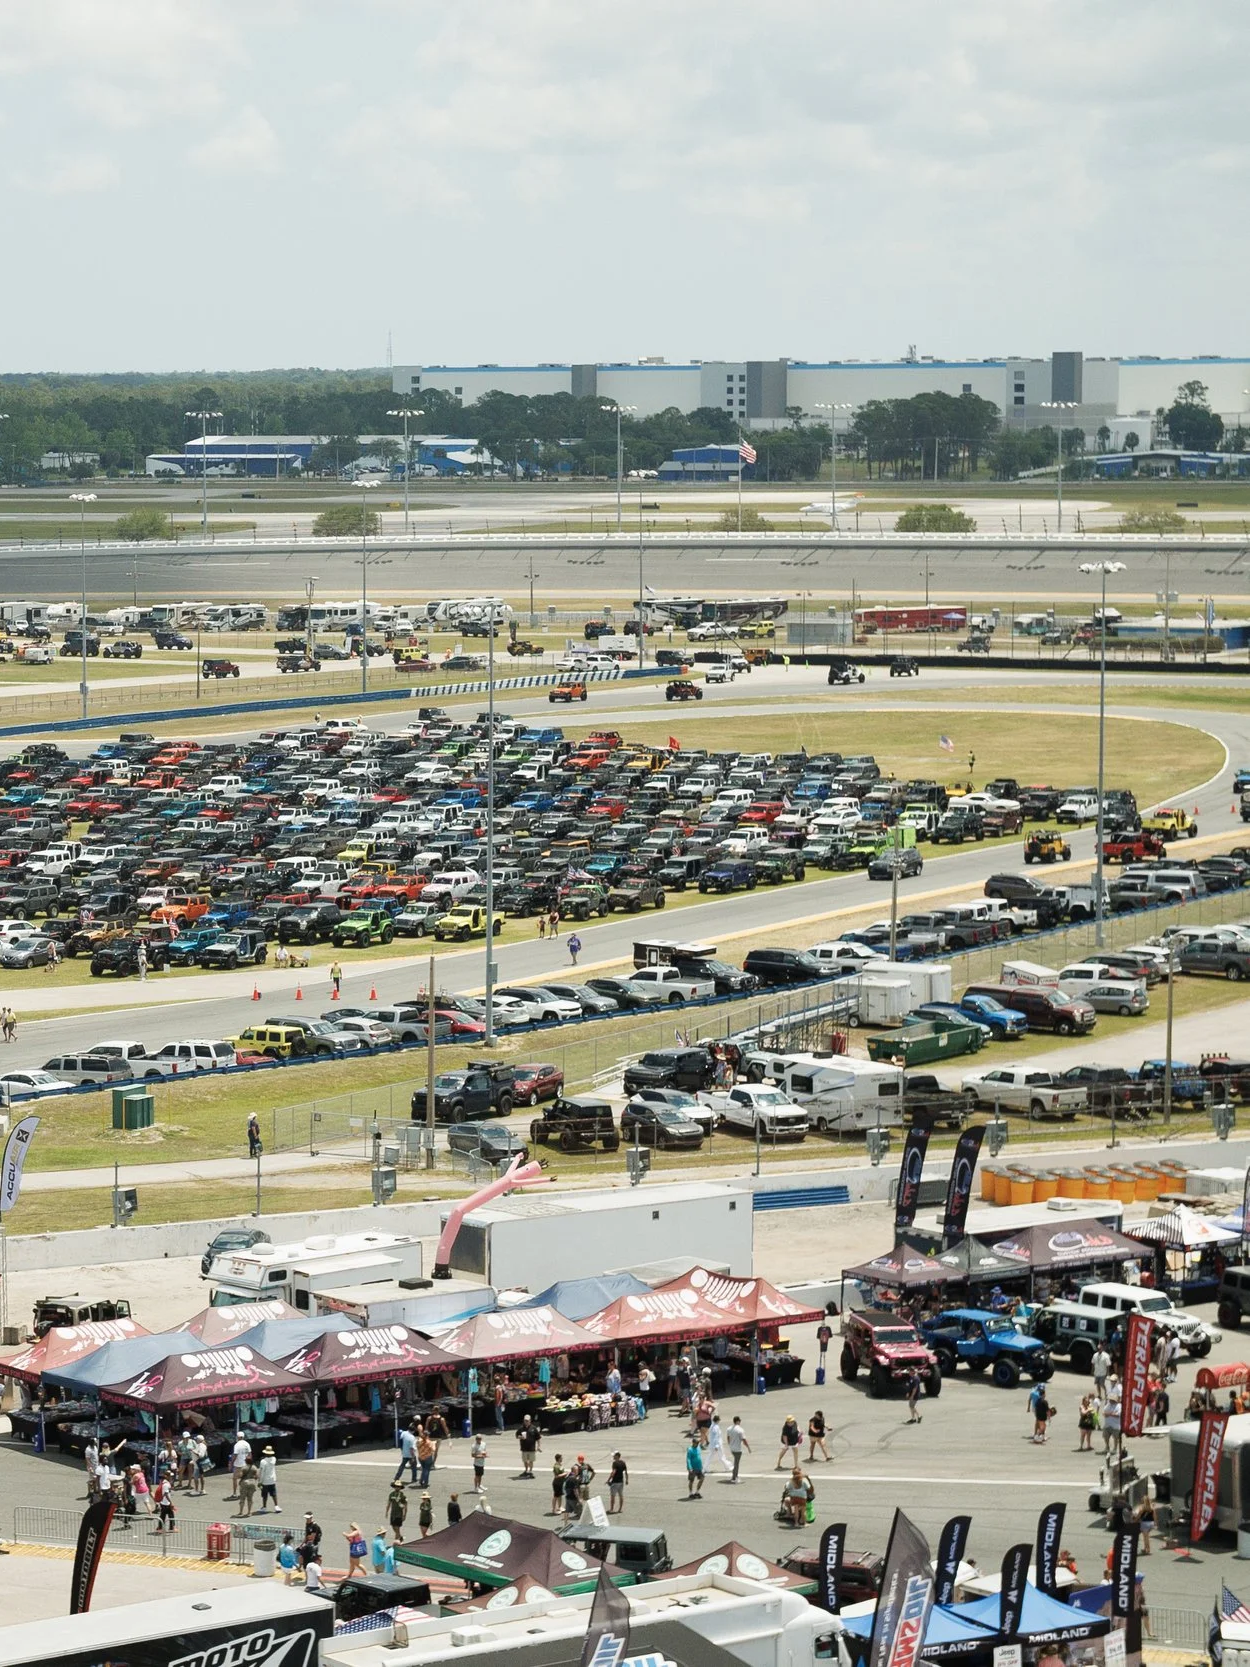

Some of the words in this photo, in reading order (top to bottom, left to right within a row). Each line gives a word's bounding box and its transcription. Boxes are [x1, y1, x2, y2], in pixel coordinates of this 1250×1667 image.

[486, 1351, 536, 1363] TOPLESS
[538, 1348, 562, 1357] FOR
[564, 1342, 601, 1353] TATAS
[633, 1334, 681, 1346] TOPLESS
[683, 1331, 706, 1341] FOR
[707, 1326, 746, 1337] TATAS
[333, 1370, 387, 1385] TOPLESS
[389, 1368, 414, 1377] FOR
[416, 1364, 457, 1375] TATAS
[1129, 1320, 1150, 1431] TERAFLEX
[175, 1395, 230, 1410] TOPLESS
[233, 1391, 258, 1401] FOR
[260, 1386, 302, 1398] TATAS
[1199, 1420, 1224, 1532] TERAFLEX
[949, 1523, 960, 1559] MIDLAND
[1043, 1513, 1059, 1587] MIDLAND
[77, 1527, 97, 1608] MOTOBILT
[827, 1535, 839, 1609] MIDLAND
[1011, 1552, 1022, 1588] MIDLAND
[1118, 1534, 1133, 1610] MIDLAND
[920, 1641, 978, 1657] MIDLAND
[999, 1648, 1016, 1657] Jeep
[1029, 1627, 1089, 1644] MIDLAND
